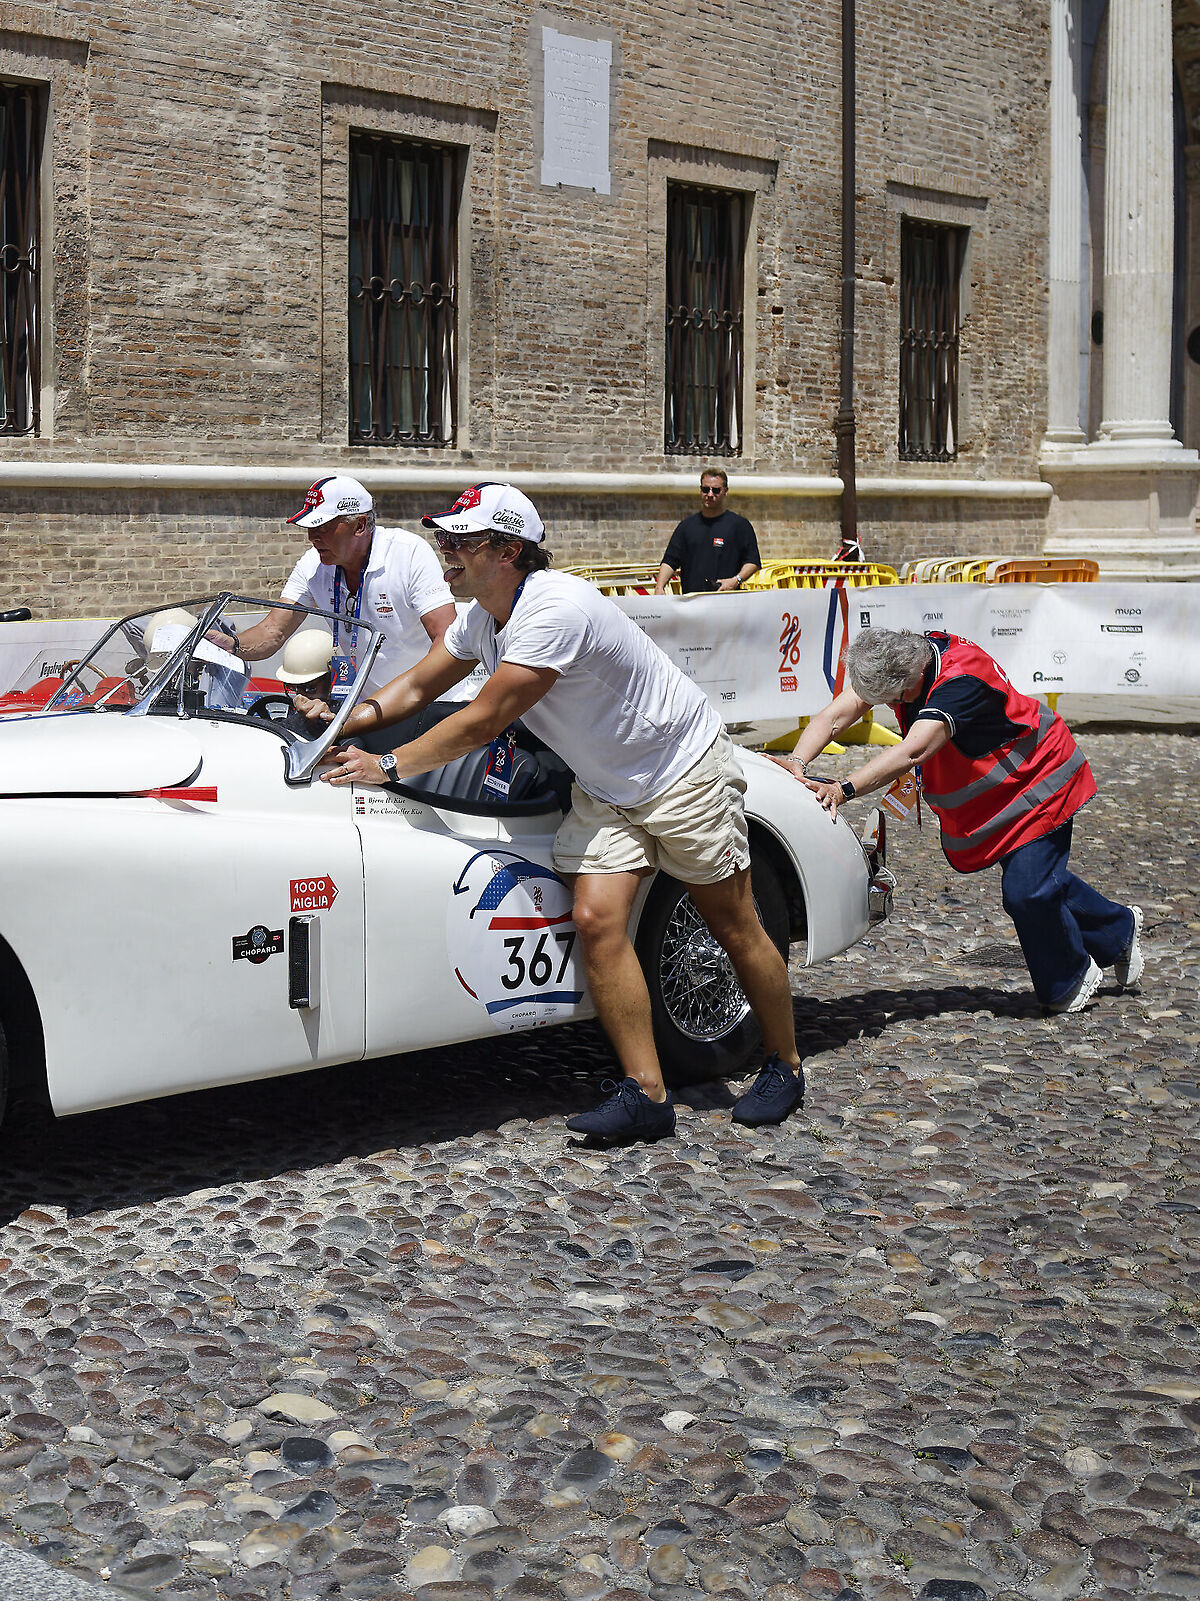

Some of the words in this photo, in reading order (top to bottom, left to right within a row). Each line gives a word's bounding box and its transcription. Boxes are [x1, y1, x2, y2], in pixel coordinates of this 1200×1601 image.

[311, 517, 323, 526] 1927
[492, 511, 525, 528] Classic
[294, 880, 326, 894] 1000
[293, 895, 328, 910] MIGLIA
[240, 945, 277, 957] CHOPARD
[501, 932, 577, 990] 367
